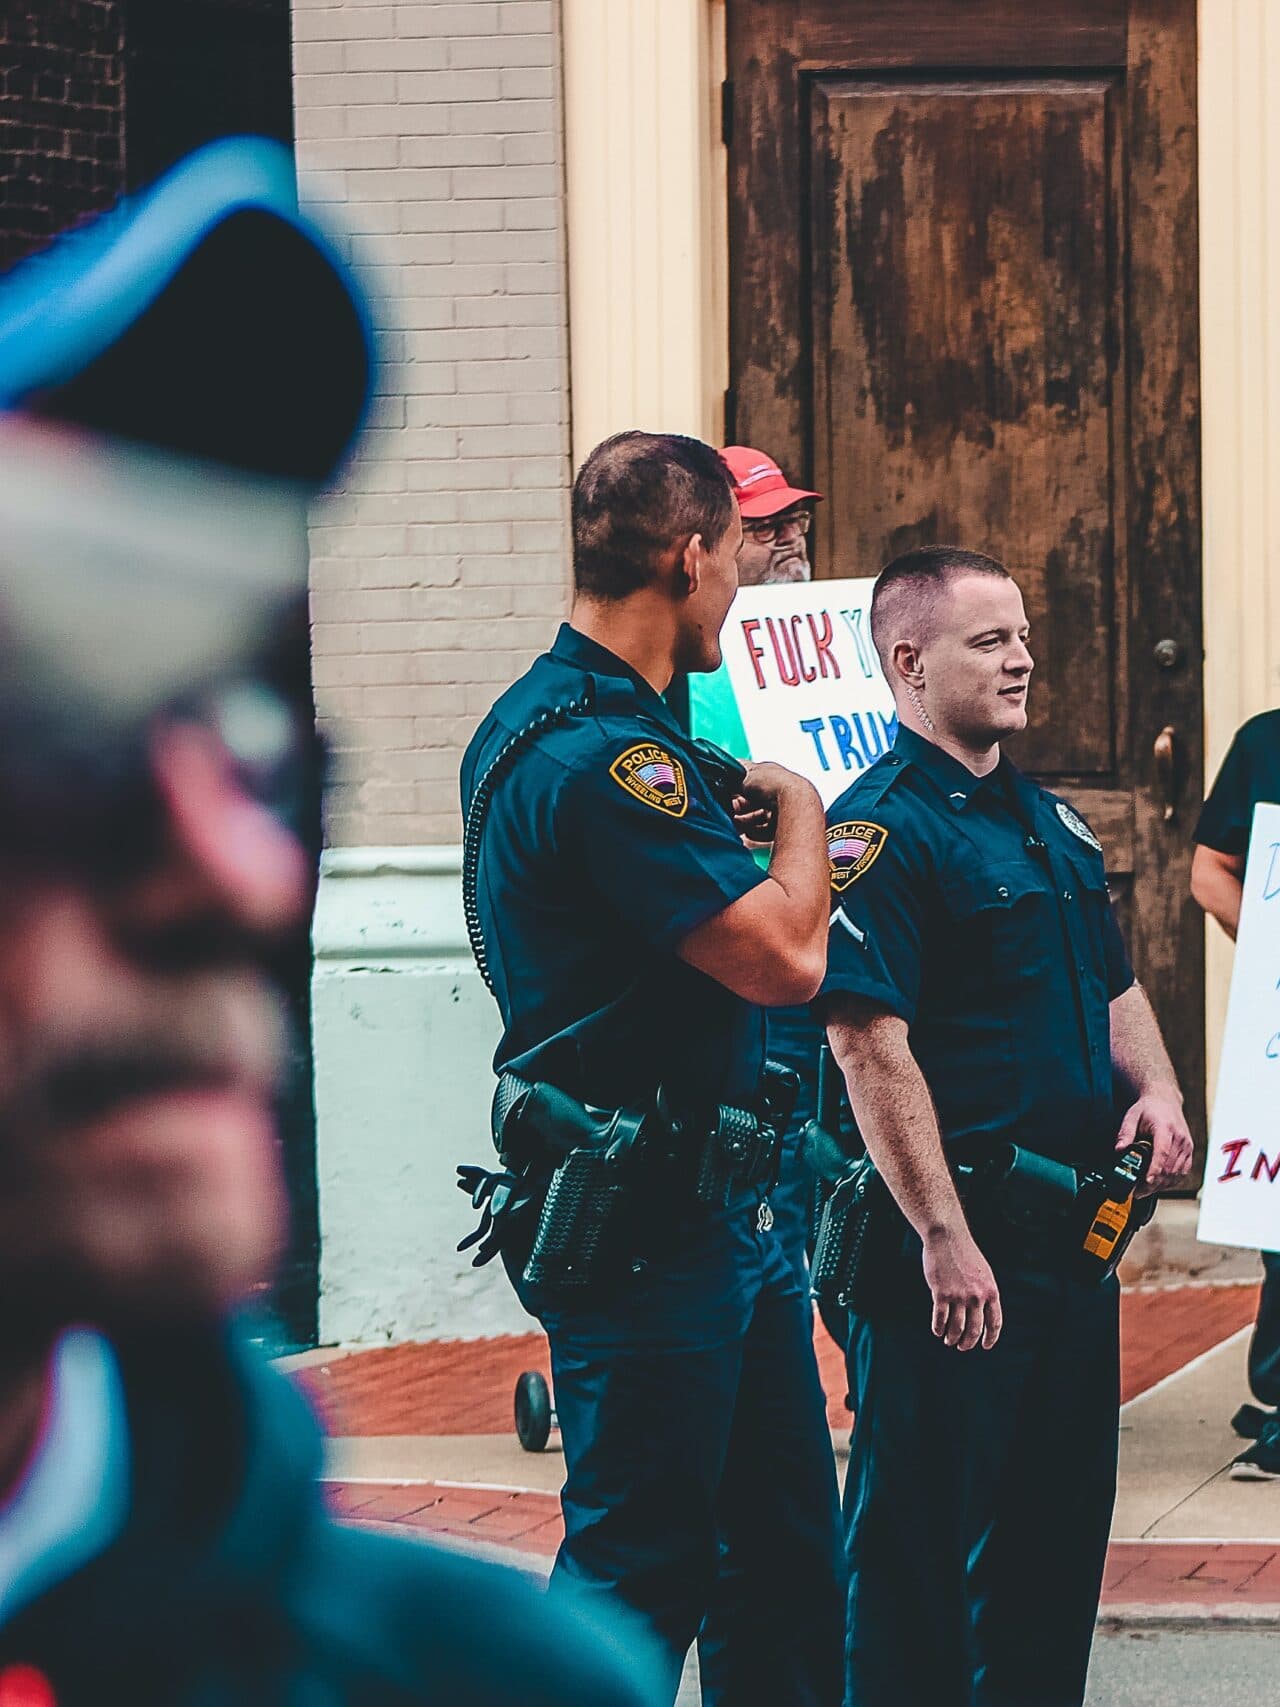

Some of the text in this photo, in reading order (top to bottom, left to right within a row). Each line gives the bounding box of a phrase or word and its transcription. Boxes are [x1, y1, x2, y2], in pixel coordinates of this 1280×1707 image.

[741, 609, 841, 690] FUCK
[621, 748, 671, 772] POLICE
[624, 775, 662, 804] WHEELING
